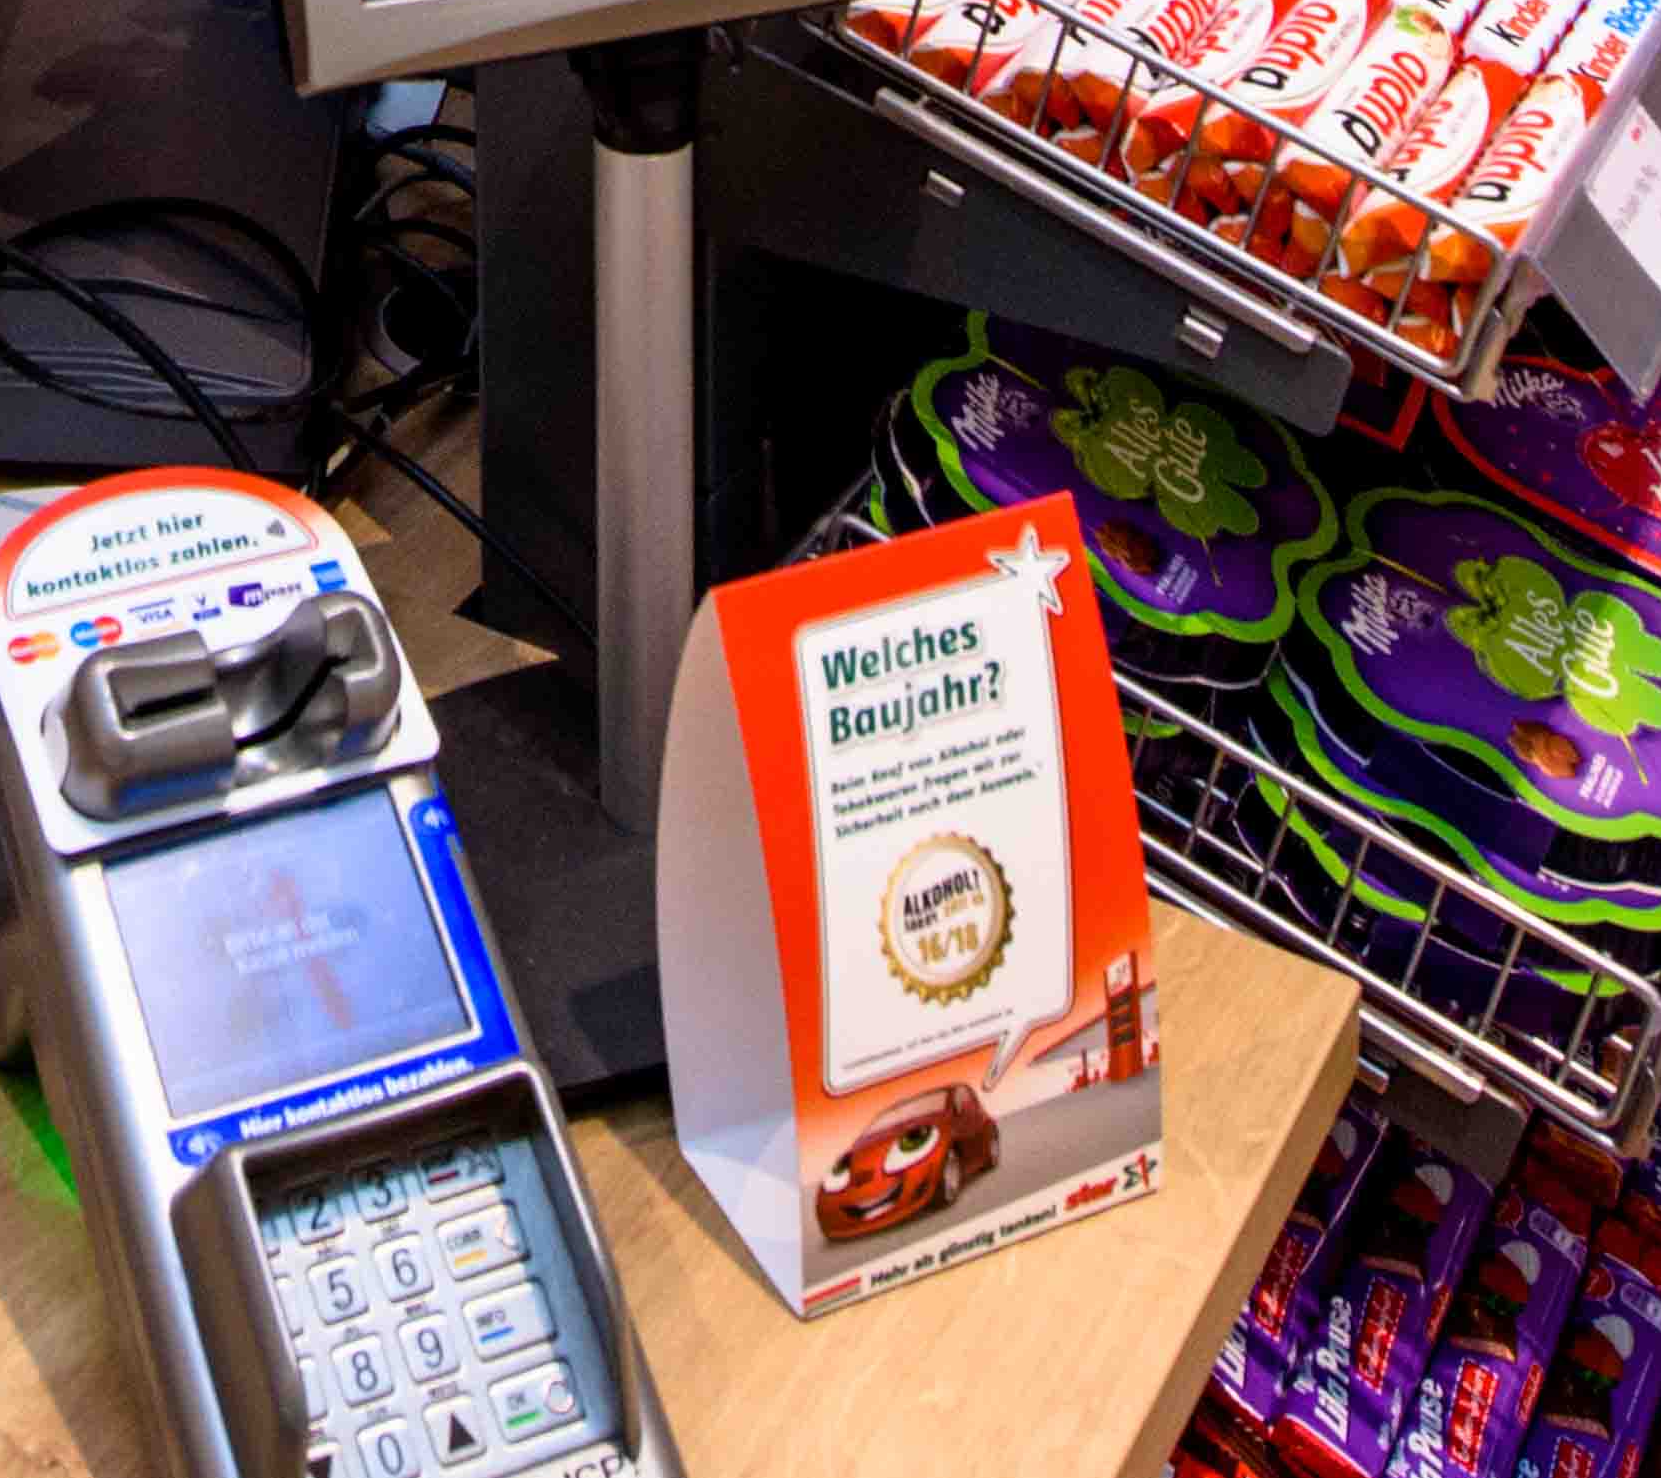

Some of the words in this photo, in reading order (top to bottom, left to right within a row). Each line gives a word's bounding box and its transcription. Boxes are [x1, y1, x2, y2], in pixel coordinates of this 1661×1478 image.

[91, 525, 148, 552] Jetzt
[157, 513, 205, 536] hier
[26, 555, 160, 597] kontaktlos
[170, 534, 259, 565] zahlen.
[138, 606, 176, 624] VISA
[822, 620, 979, 690] Welches
[1504, 589, 1561, 678] Alles
[1560, 609, 1621, 700] Gute
[829, 660, 1001, 745] Baujahr?
[917, 922, 979, 962] 16/18
[240, 1108, 282, 1140] Hier
[285, 1079, 385, 1127] kontaktlos
[388, 1055, 475, 1094] bezahlen.
[1064, 1178, 1118, 1211] star
[327, 1273, 355, 1299] 5
[391, 1249, 418, 1288] 6
[417, 1328, 445, 1369] 9
[351, 1353, 378, 1392] 8
